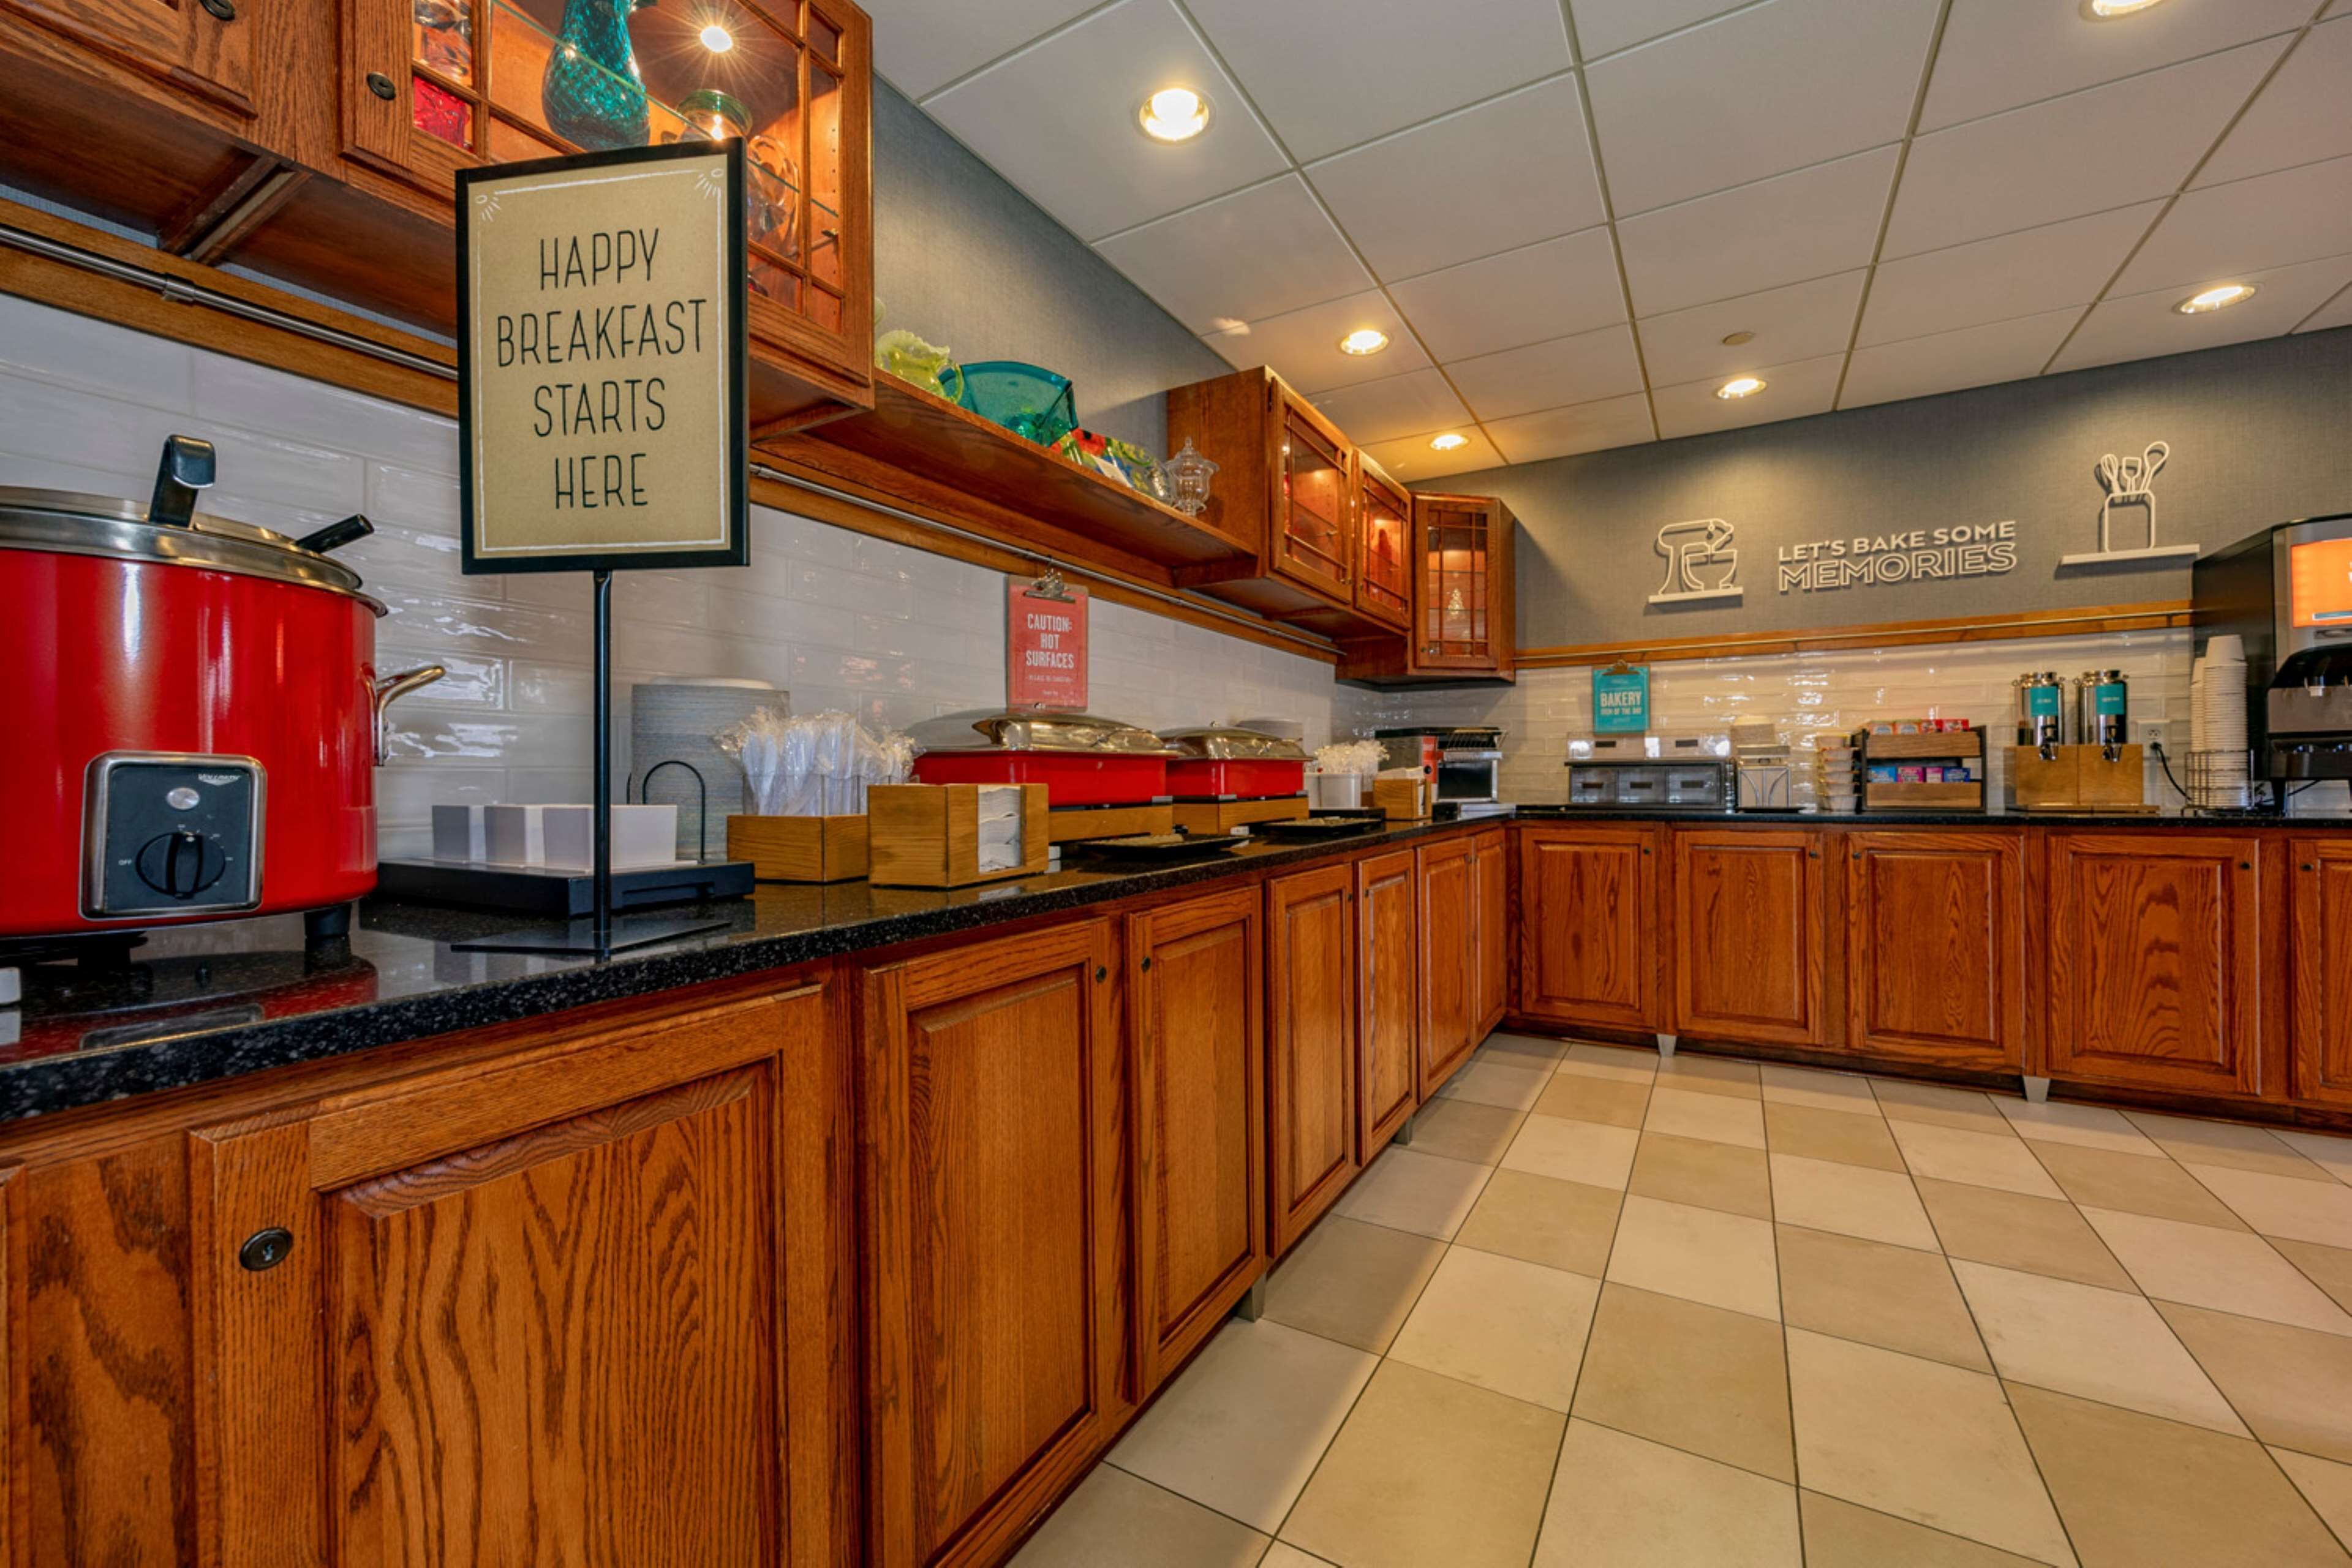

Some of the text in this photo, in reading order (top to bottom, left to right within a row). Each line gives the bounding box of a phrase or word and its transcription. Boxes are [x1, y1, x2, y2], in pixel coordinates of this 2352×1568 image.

[540, 228, 659, 291] HAPPY
[497, 299, 707, 367] BREAKFAST
[533, 377, 666, 438] STARTS
[555, 453, 648, 509] HERE
[1779, 521, 2017, 562] LET'S BAKE SOME
[1779, 541, 2018, 592] MEMORIES
[1027, 613, 1072, 632] CAUTION:
[1040, 633, 1060, 650] HOT
[1026, 650, 1074, 669] SURFACES
[1600, 691, 1642, 707] BAKERY
